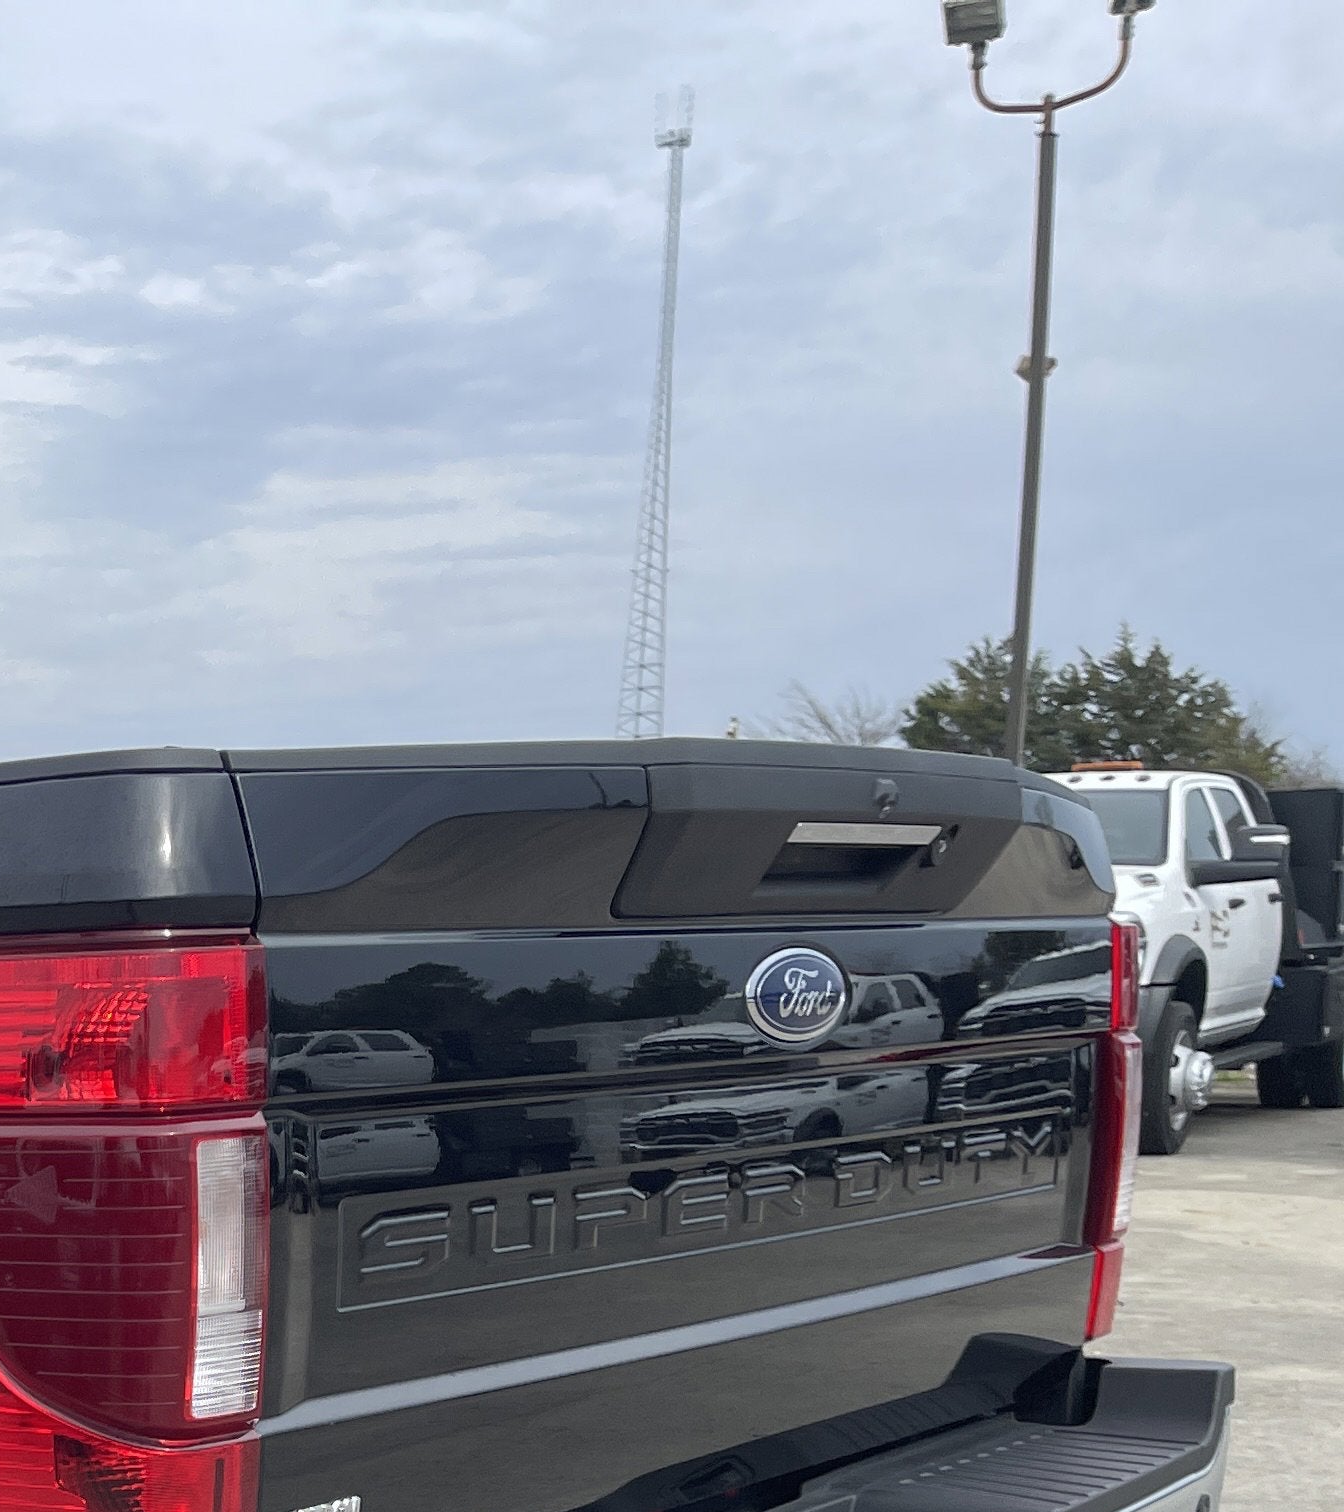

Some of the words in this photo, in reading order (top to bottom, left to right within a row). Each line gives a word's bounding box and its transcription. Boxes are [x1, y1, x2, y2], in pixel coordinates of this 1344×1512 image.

[779, 967, 833, 1018] Ford
[359, 1162, 806, 1278] SUPER
[835, 1125, 1053, 1208] DUTY
